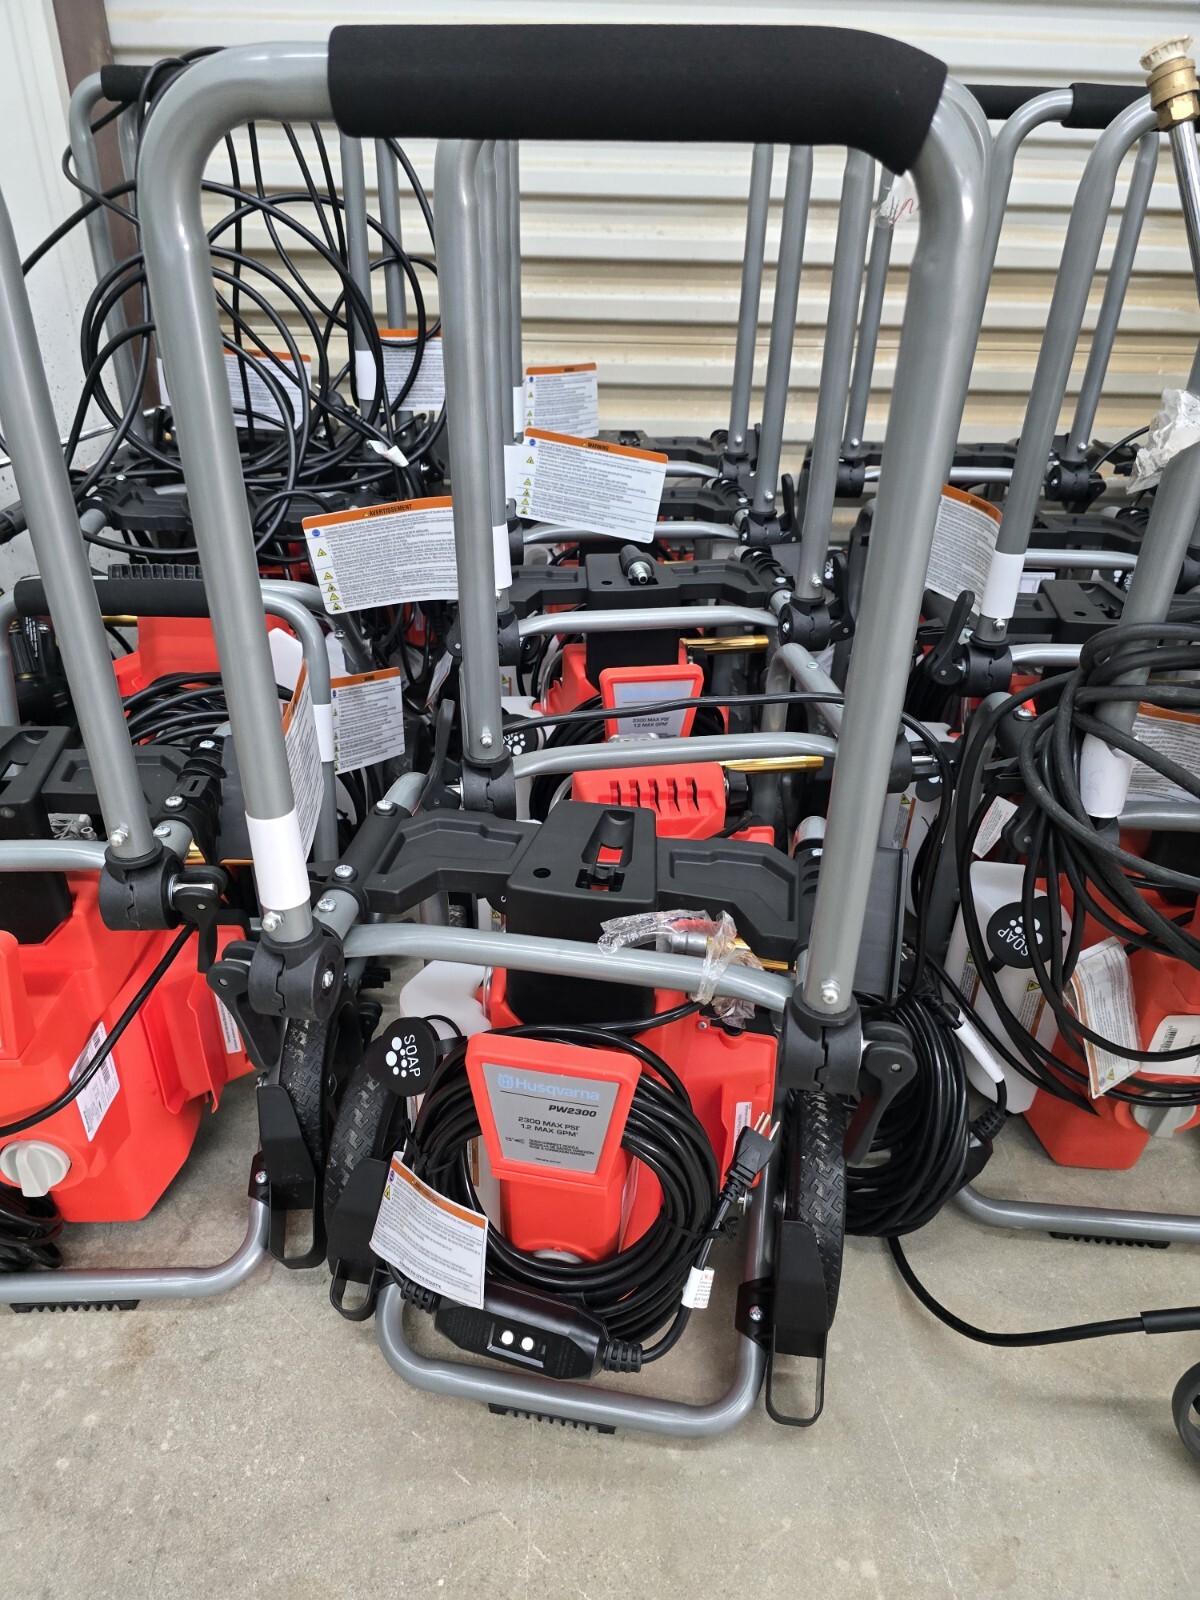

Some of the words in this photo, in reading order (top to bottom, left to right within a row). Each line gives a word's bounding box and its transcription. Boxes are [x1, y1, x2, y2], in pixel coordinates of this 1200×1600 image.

[369, 504, 412, 516] AVERTISSEMENT
[403, 1034, 421, 1077] SOAP
[515, 1078, 600, 1101] Husqvarna
[548, 1104, 597, 1118] PW2300
[518, 1116, 541, 1125] 2300
[542, 1120, 563, 1129] MAX
[520, 1123, 532, 1131] 1.2
[534, 1126, 554, 1134] MAX
